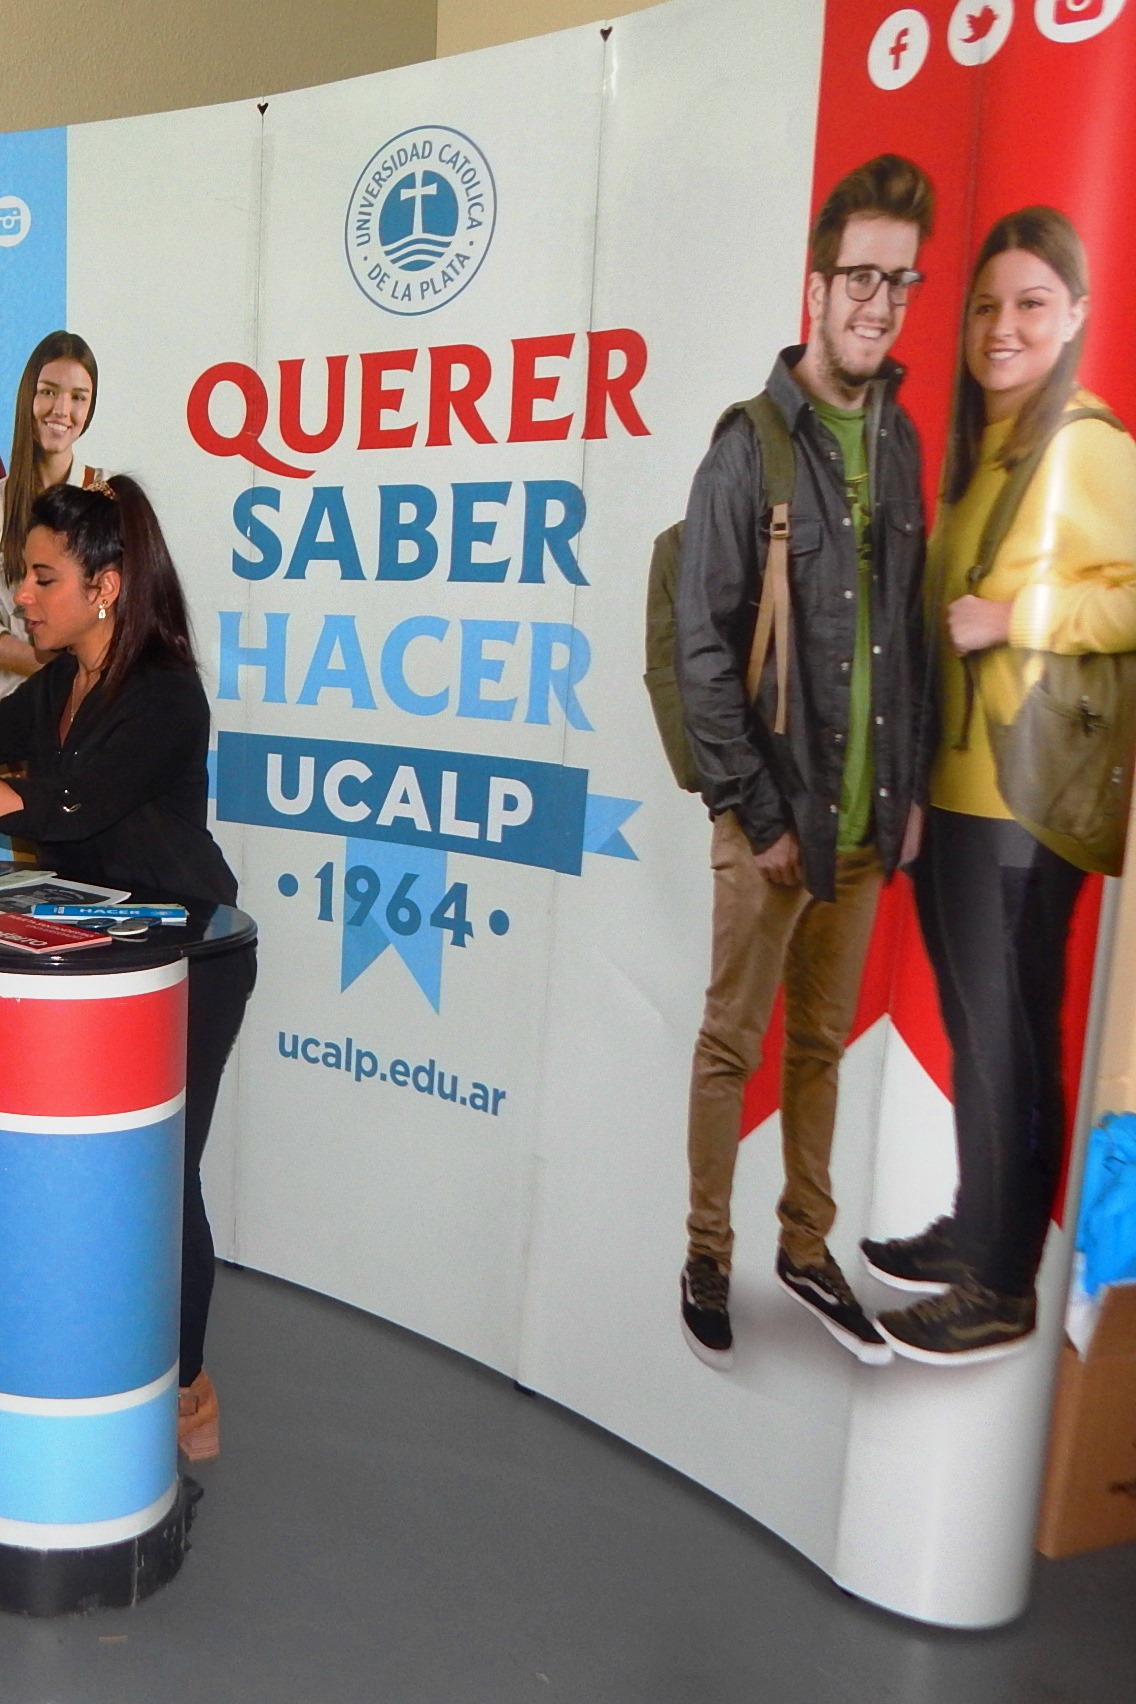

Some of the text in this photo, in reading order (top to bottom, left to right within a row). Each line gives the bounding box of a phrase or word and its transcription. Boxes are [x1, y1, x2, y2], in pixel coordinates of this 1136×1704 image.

[356, 140, 485, 248] UNIVERSIDAD CATOLICA
[367, 251, 471, 302] DE LA PLATA
[186, 327, 653, 480] QUERER
[231, 479, 591, 587] SABER
[216, 611, 596, 732] HACER
[266, 753, 533, 844] UCALP
[79, 908, 140, 916] HACER
[313, 861, 474, 948] 1964
[277, 1031, 507, 1117] ucalp.edu.ar
